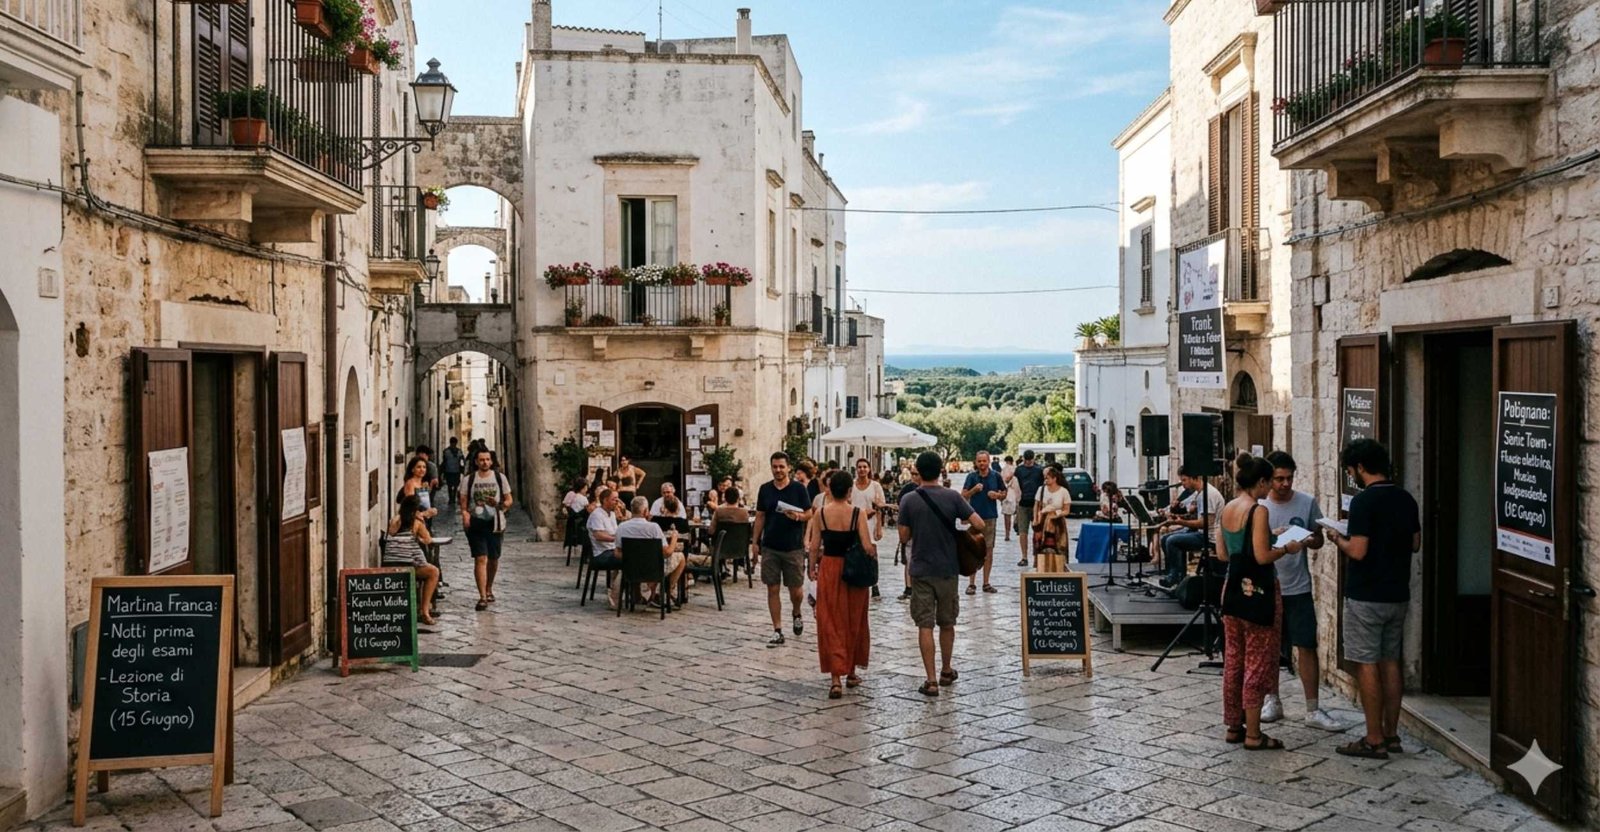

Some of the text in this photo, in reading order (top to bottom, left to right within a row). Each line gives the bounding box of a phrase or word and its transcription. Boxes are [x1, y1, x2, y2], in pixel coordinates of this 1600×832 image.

[107, 593, 218, 612] Martina Franca:
[153, 625, 195, 643] prima
[112, 643, 193, 663] degli esami
[170, 667, 184, 682] di
[122, 687, 171, 704] Storia
[110, 706, 194, 731] (15 Giugno)
